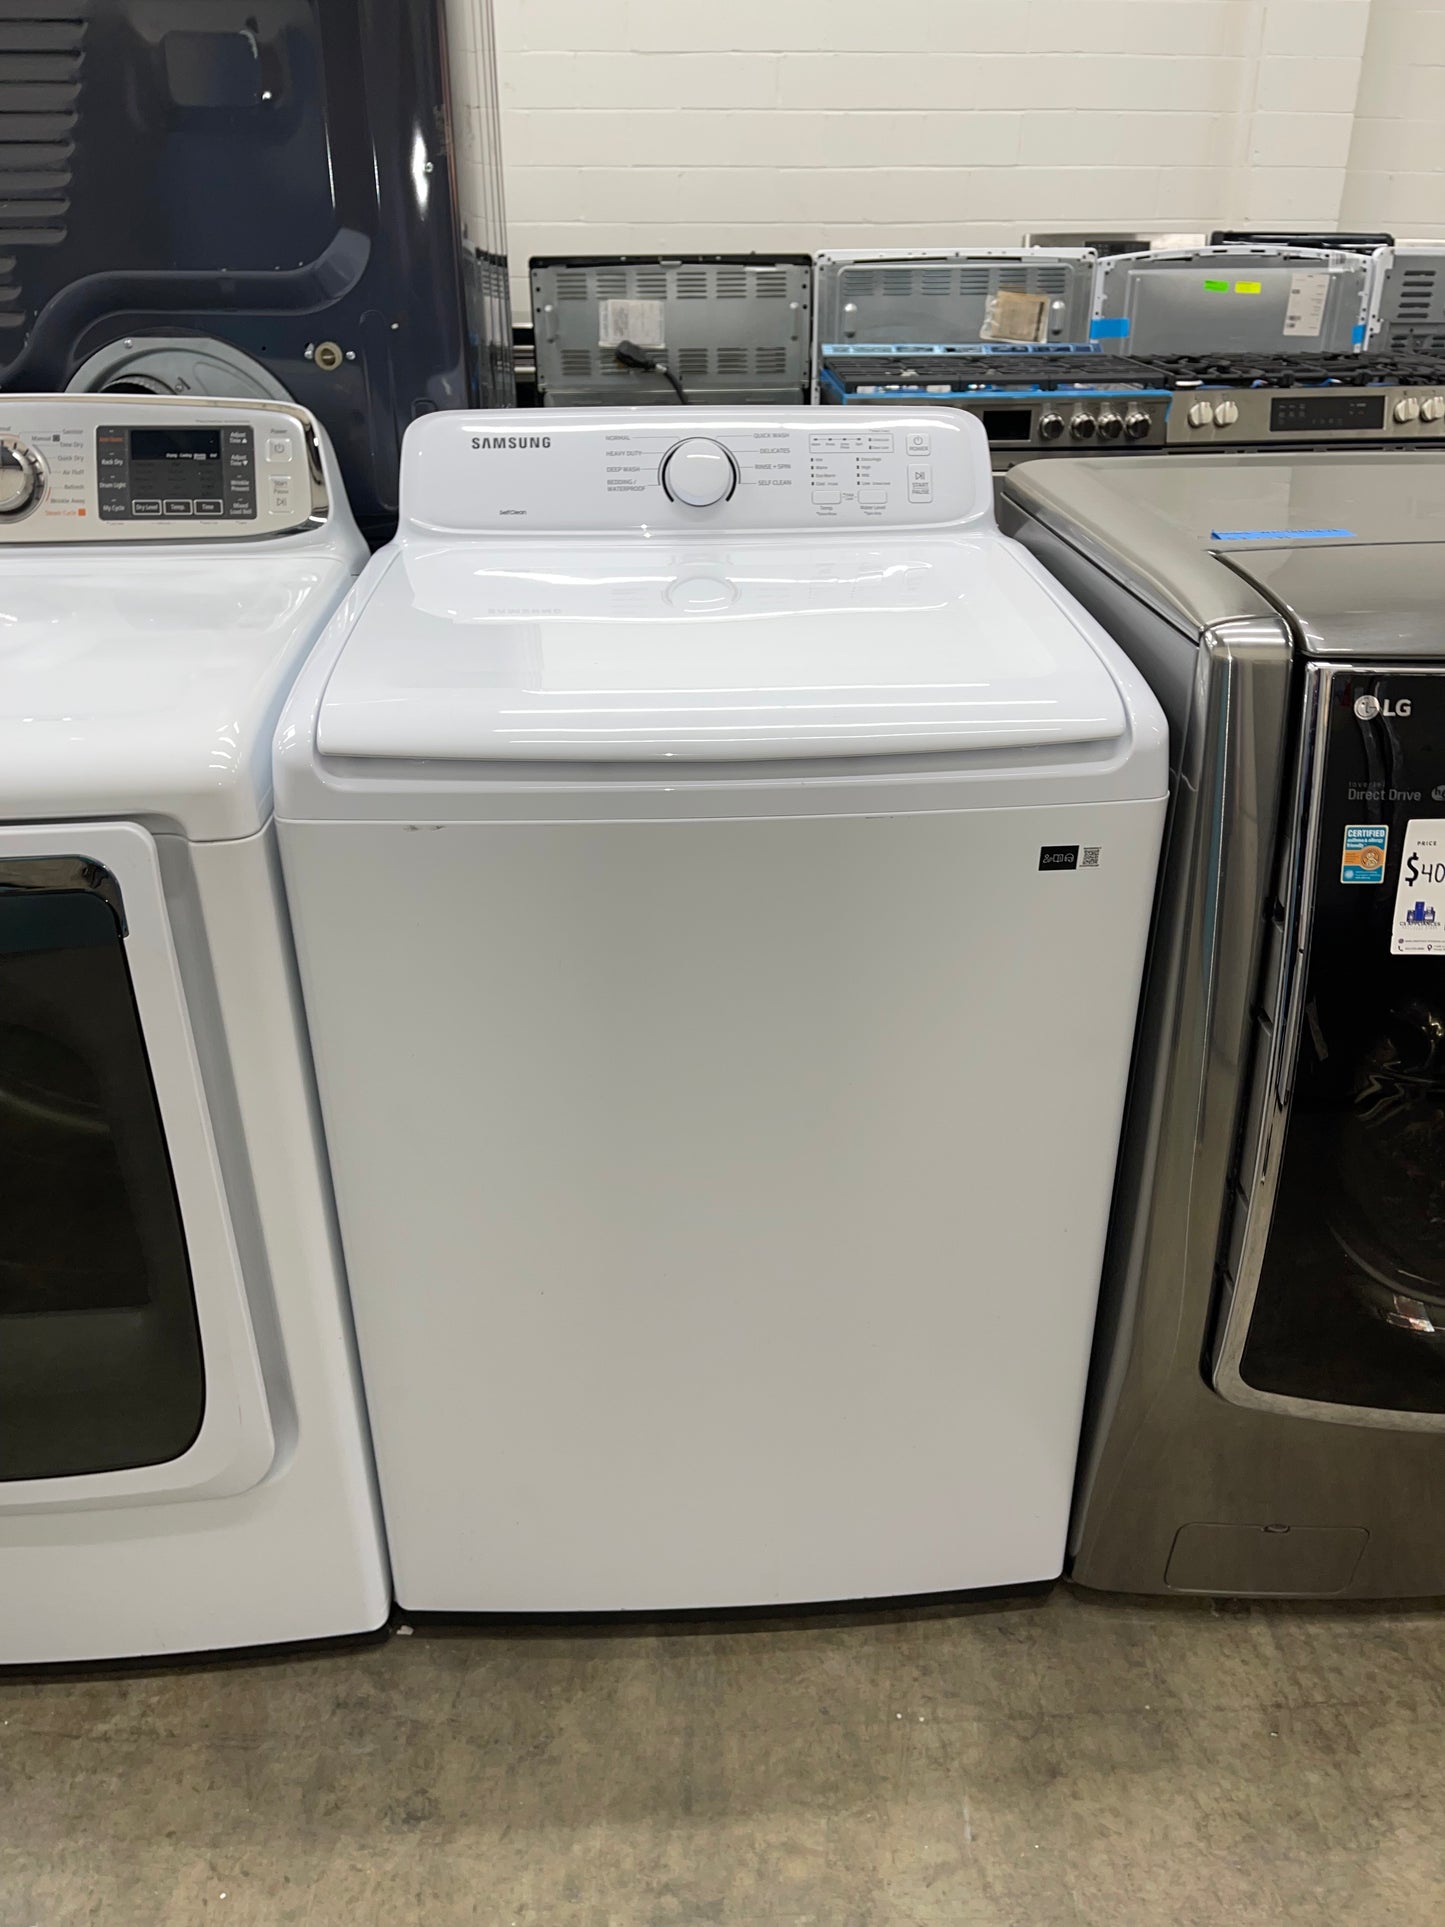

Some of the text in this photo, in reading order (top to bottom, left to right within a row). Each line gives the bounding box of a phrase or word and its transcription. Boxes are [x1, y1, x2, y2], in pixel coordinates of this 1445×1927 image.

[471, 437, 551, 449] SAMSUNG
[1383, 699, 1412, 717] LG
[1347, 788, 1386, 801] Direct
[1388, 788, 1422, 801] Drive
[1347, 829, 1385, 838] CERTIFIED
